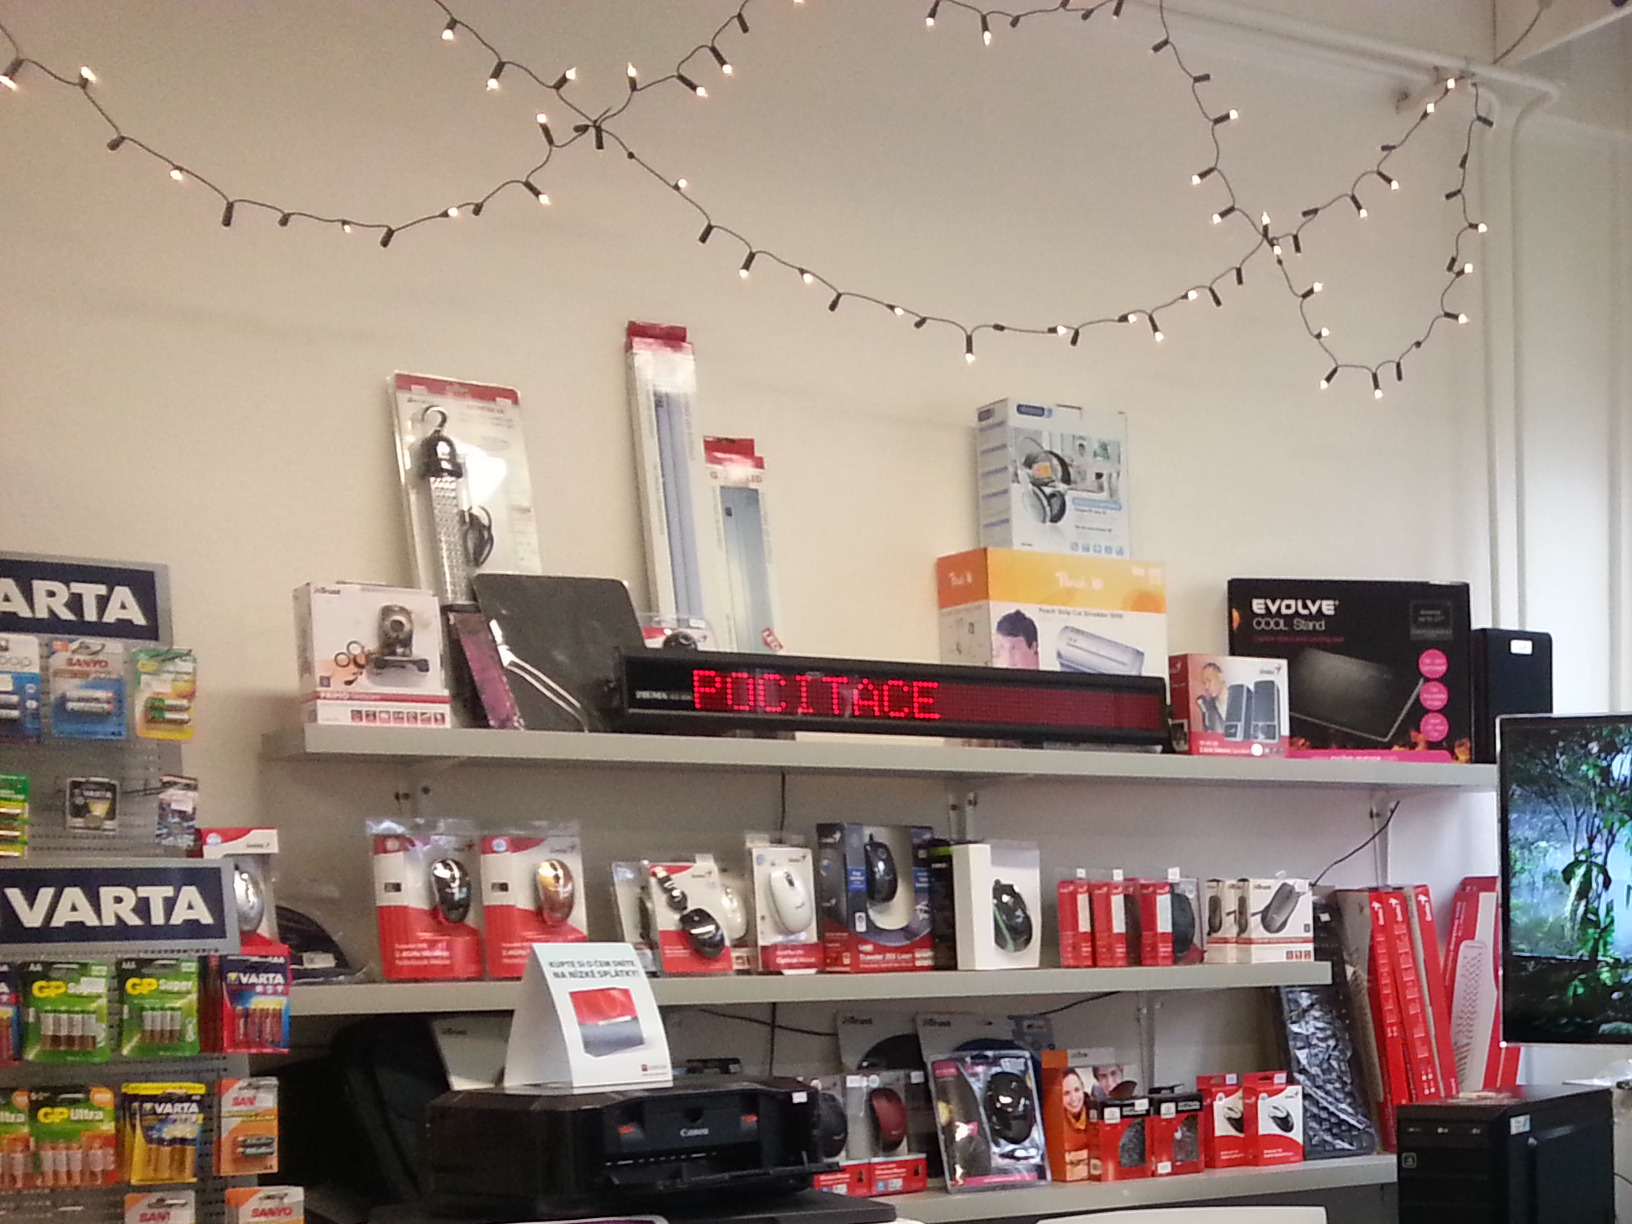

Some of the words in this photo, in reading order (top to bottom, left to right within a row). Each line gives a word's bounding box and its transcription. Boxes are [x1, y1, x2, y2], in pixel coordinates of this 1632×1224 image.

[0, 577, 148, 627] ARTA
[1251, 599, 1336, 616] EVOLVE
[1253, 618, 1288, 631] COOL
[1293, 618, 1326, 631] Stand
[692, 669, 940, 721] POCITACE
[3, 885, 215, 929] VARTA
[239, 972, 286, 985] VARTA
[32, 981, 67, 998] GP
[125, 978, 159, 995] GP
[159, 978, 194, 992] Super
[154, 1101, 200, 1114] VARTA
[231, 1096, 257, 1107] SAN
[0, 1111, 26, 1124] ltra
[36, 1106, 69, 1124] GP
[70, 1107, 104, 1122] Ultra
[139, 1211, 171, 1223] SAN
[251, 1206, 293, 1218] SANYO
